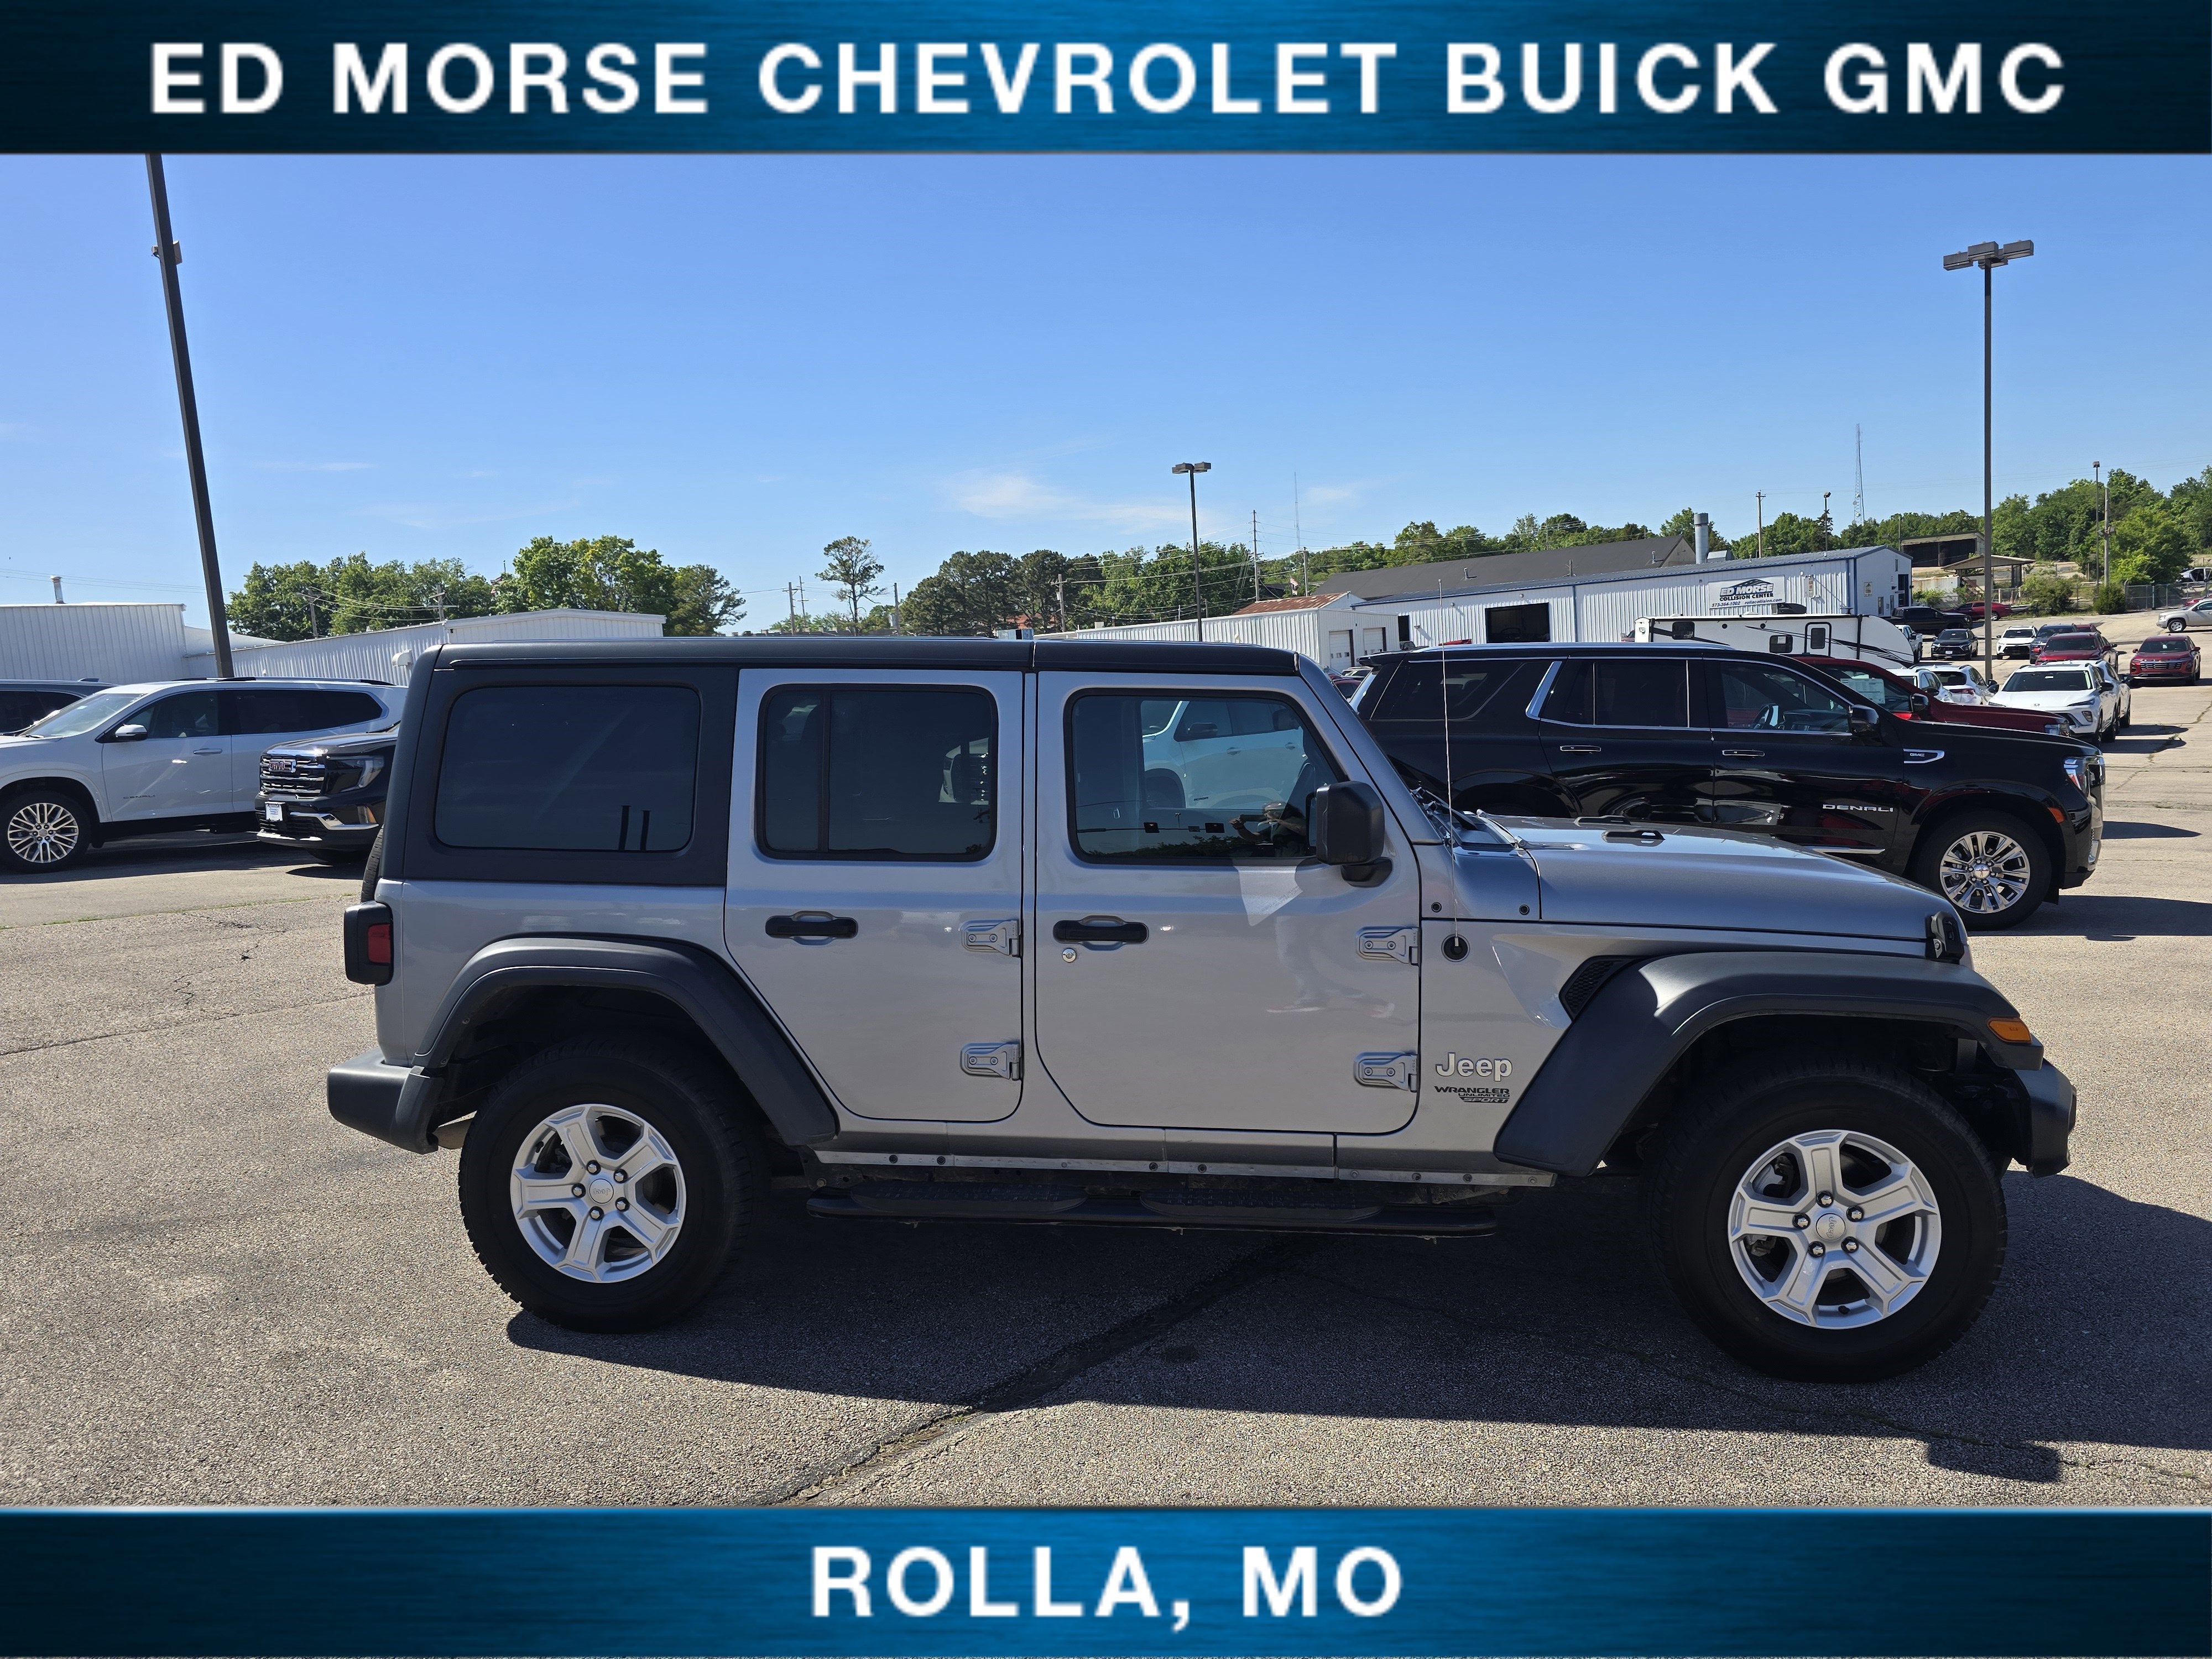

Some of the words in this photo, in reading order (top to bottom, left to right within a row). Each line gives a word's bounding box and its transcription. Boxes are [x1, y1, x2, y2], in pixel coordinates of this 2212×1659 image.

[1720, 587, 1735, 597] ED
[1735, 583, 1773, 596] MORSE
[269, 761, 291, 770] GMC
[1822, 804, 1893, 812] DENALI
[1436, 1052, 1512, 1082] Jeep
[1434, 1086, 1510, 1094] WRANGLER
[1826, 1217, 1837, 1238] Jeep
